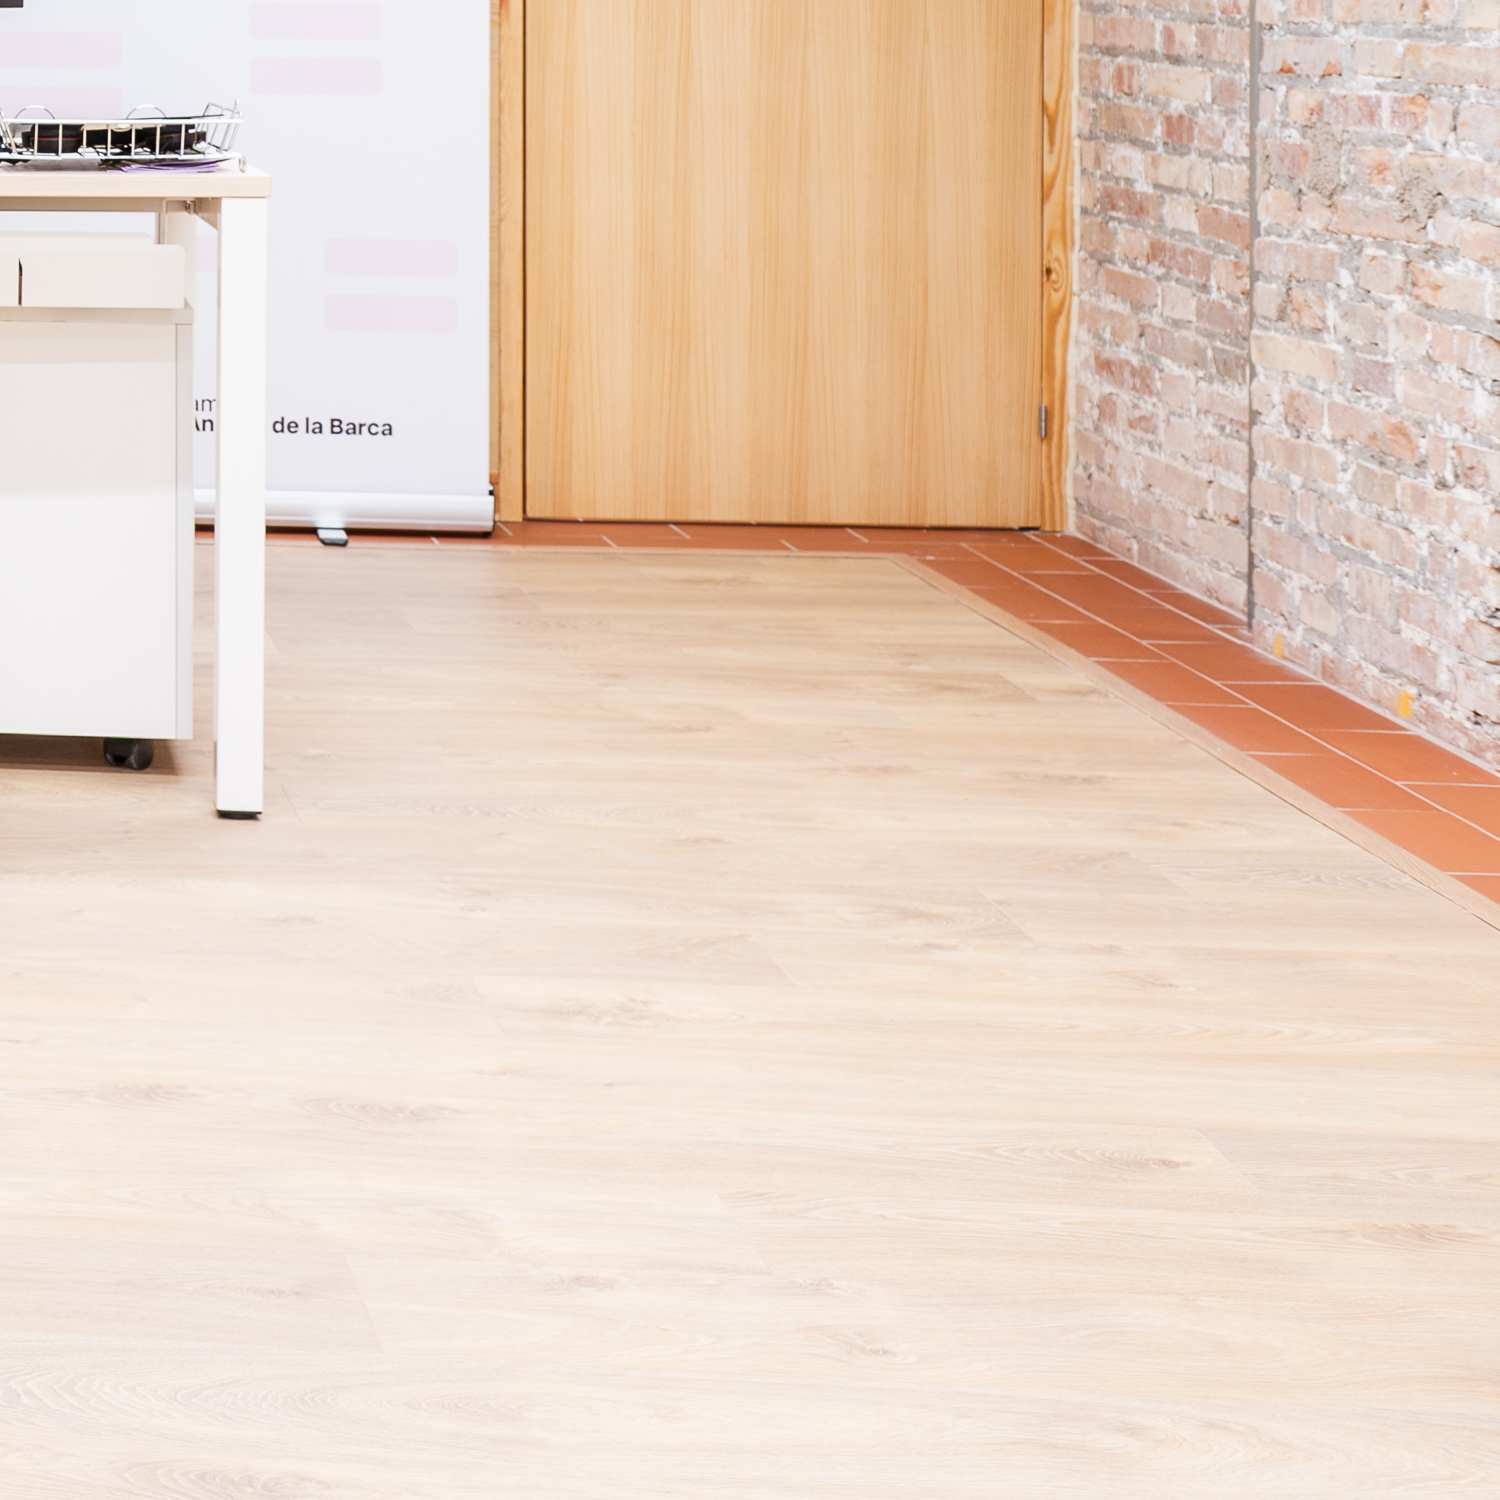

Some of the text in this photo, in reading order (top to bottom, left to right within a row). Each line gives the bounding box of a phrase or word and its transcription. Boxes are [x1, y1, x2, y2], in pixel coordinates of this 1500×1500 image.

[272, 416, 393, 436] de la Barca
